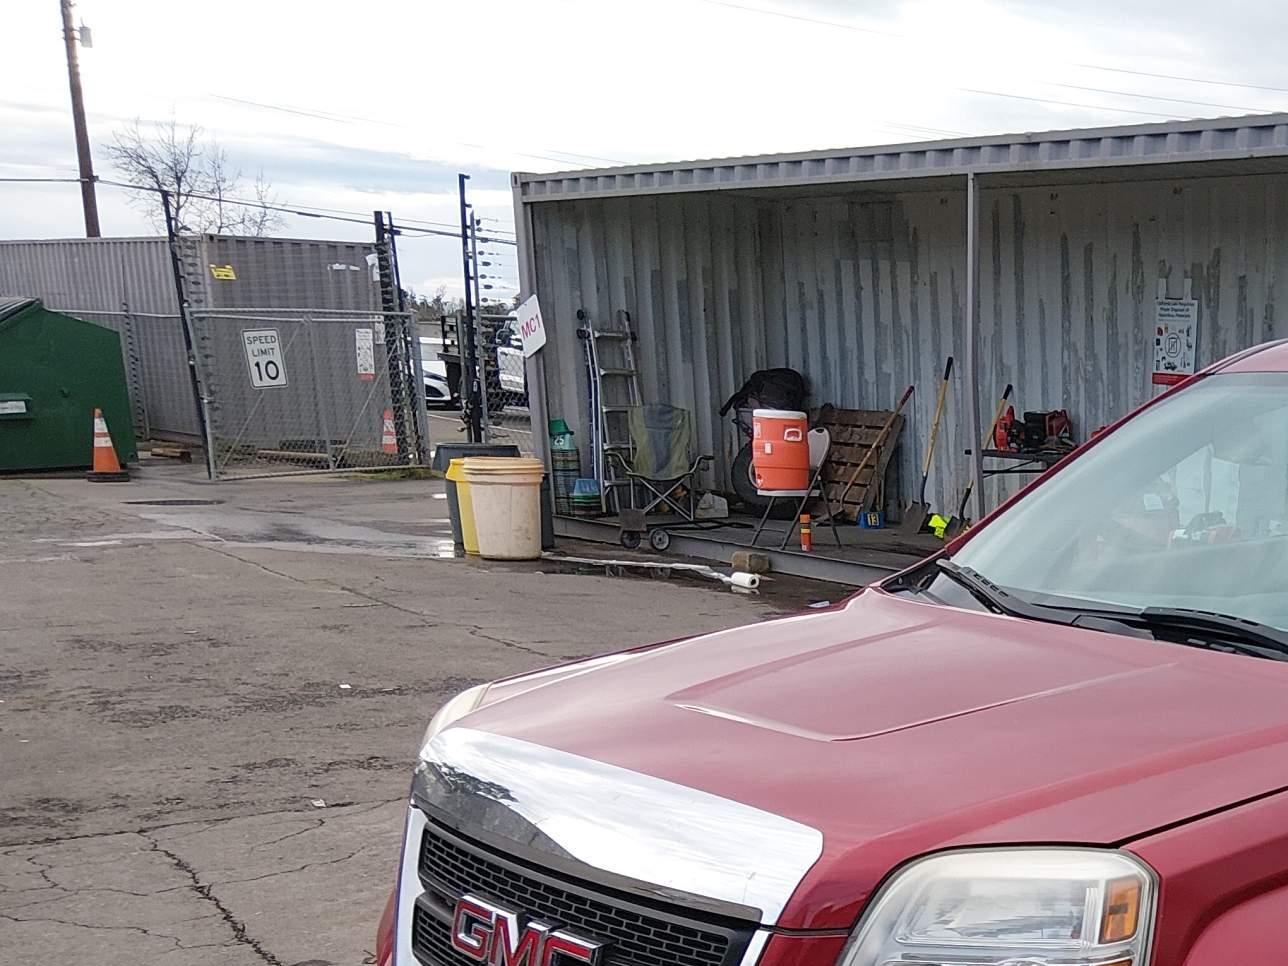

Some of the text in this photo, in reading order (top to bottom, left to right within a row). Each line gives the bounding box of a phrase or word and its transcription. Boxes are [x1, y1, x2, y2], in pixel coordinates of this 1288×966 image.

[521, 313, 541, 341] MC1
[246, 335, 277, 345] SPEED
[251, 347, 275, 357] LIMIT
[254, 360, 280, 382] 10
